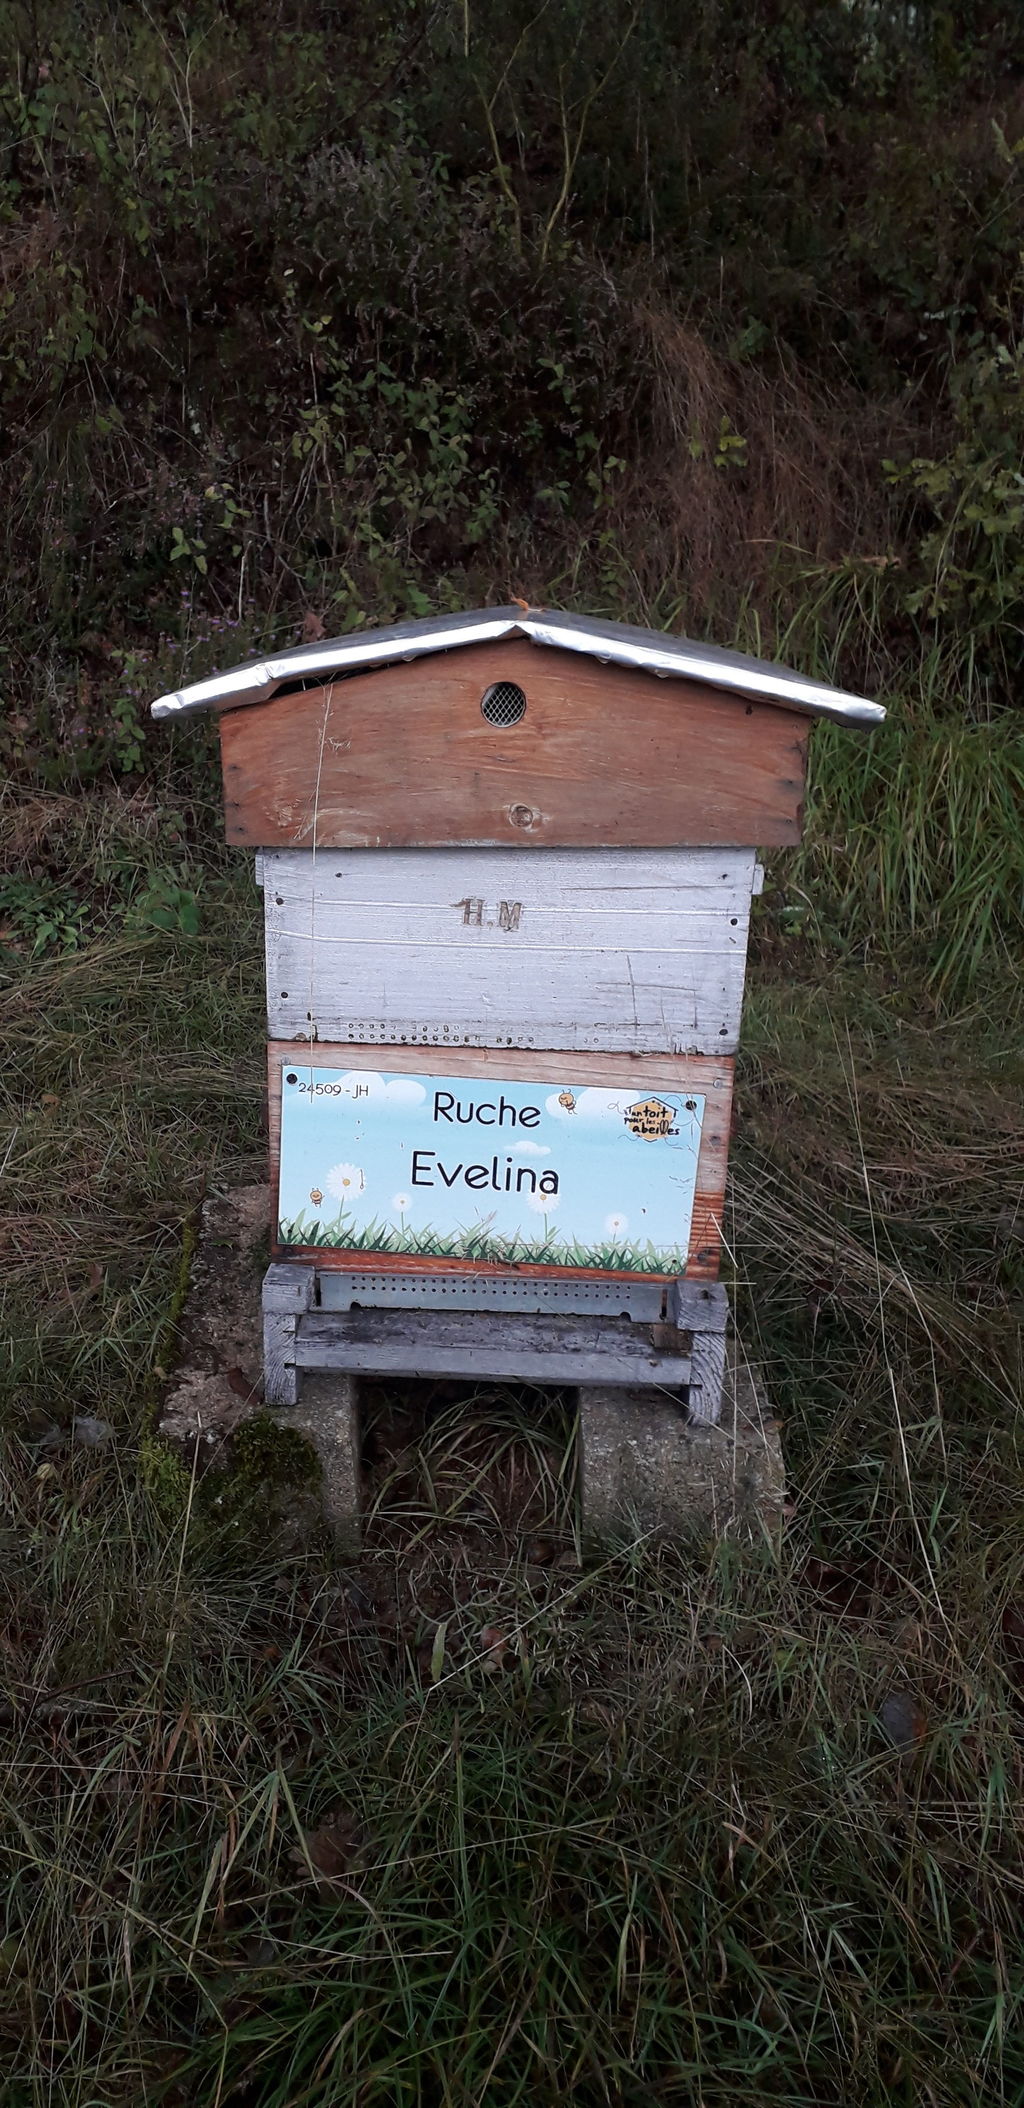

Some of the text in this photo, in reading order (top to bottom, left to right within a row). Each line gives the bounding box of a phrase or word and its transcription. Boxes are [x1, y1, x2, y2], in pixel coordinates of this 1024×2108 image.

[298, 1082, 342, 1097] 24509
[351, 1084, 369, 1099] JH
[433, 1091, 541, 1128] Ruche
[643, 1105, 668, 1118] toit
[624, 1117, 656, 1125] pour les
[632, 1119, 680, 1136] abeilles
[411, 1150, 560, 1195] Evelina
